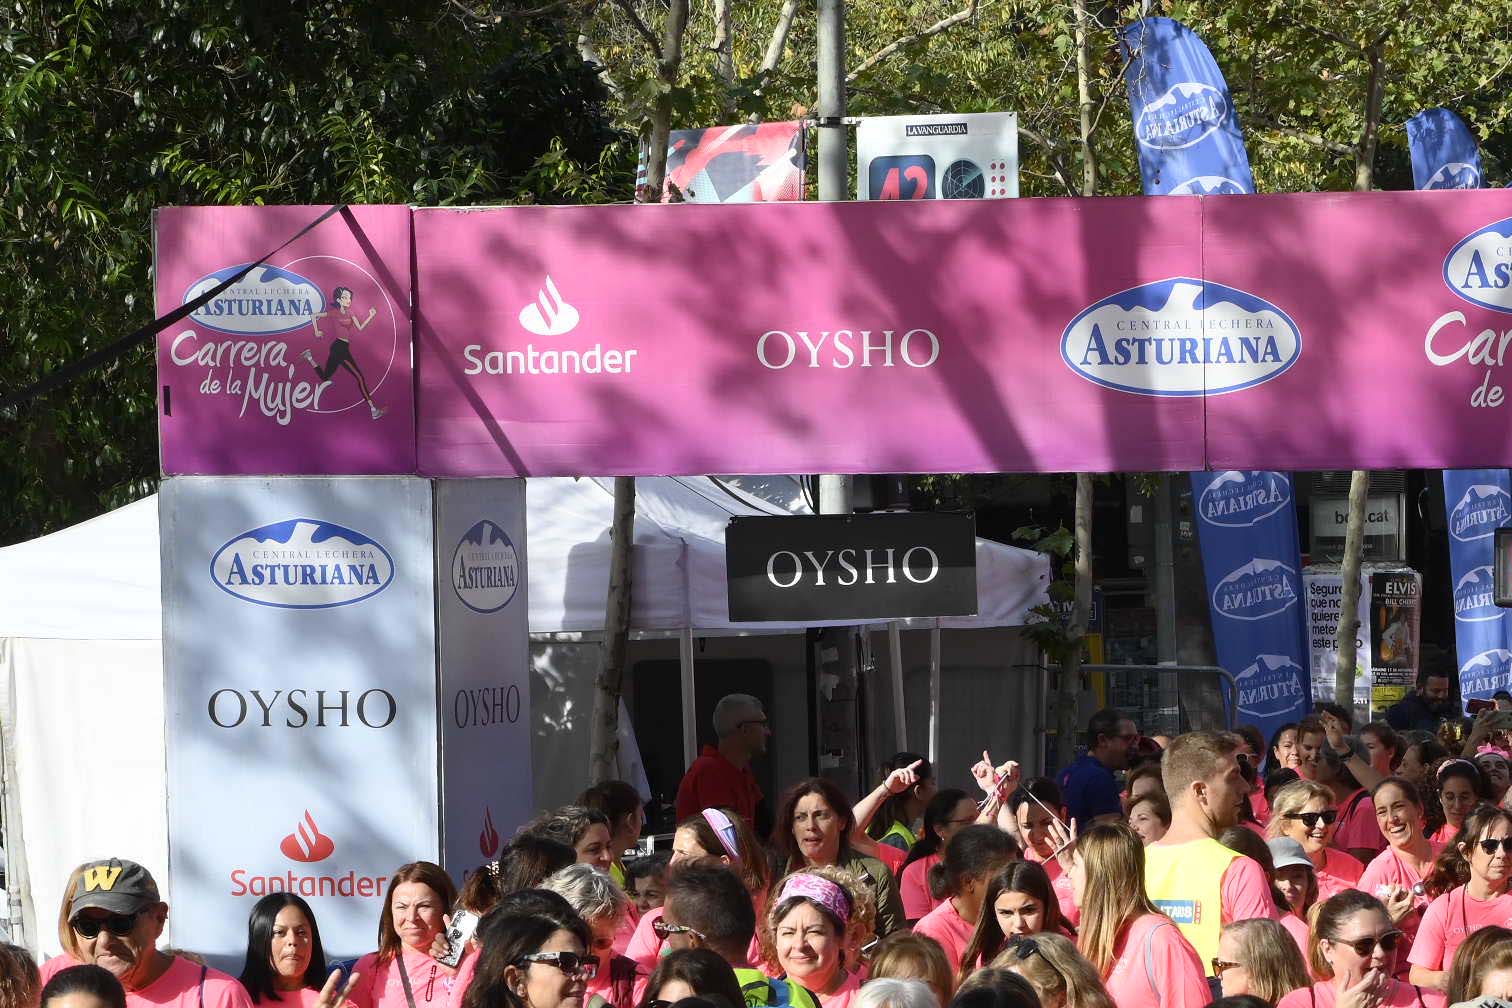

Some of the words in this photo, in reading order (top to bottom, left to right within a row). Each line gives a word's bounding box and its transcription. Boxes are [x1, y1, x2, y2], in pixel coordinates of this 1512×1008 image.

[919, 124, 967, 136] VANGUARDIA
[221, 287, 261, 296] ENTRAL
[264, 286, 310, 296] LECHERA
[1116, 320, 1192, 332] CENTRAL
[1200, 318, 1275, 330] LECHERA
[171, 330, 288, 367] Carrera
[464, 343, 637, 375] Santander
[756, 329, 939, 369] OYSHO
[1080, 323, 1283, 366] ASTURIANA
[200, 370, 220, 394] de
[226, 369, 241, 394] la
[240, 364, 332, 425] Mujer
[1470, 370, 1504, 408] de
[225, 552, 381, 587] ASTURIANA
[252, 550, 312, 560] CENTRAL
[315, 549, 375, 560] LECHERA
[766, 546, 939, 588] OYSHO
[458, 554, 515, 590] ASTURIANA
[1386, 582, 1416, 594] ELVIS
[1311, 599, 1328, 610] que
[1313, 638, 1331, 648] este
[207, 688, 397, 729] OYSHO
[455, 685, 521, 729] OYSHO
[84, 865, 123, 892] W
[230, 869, 388, 897] Santander
